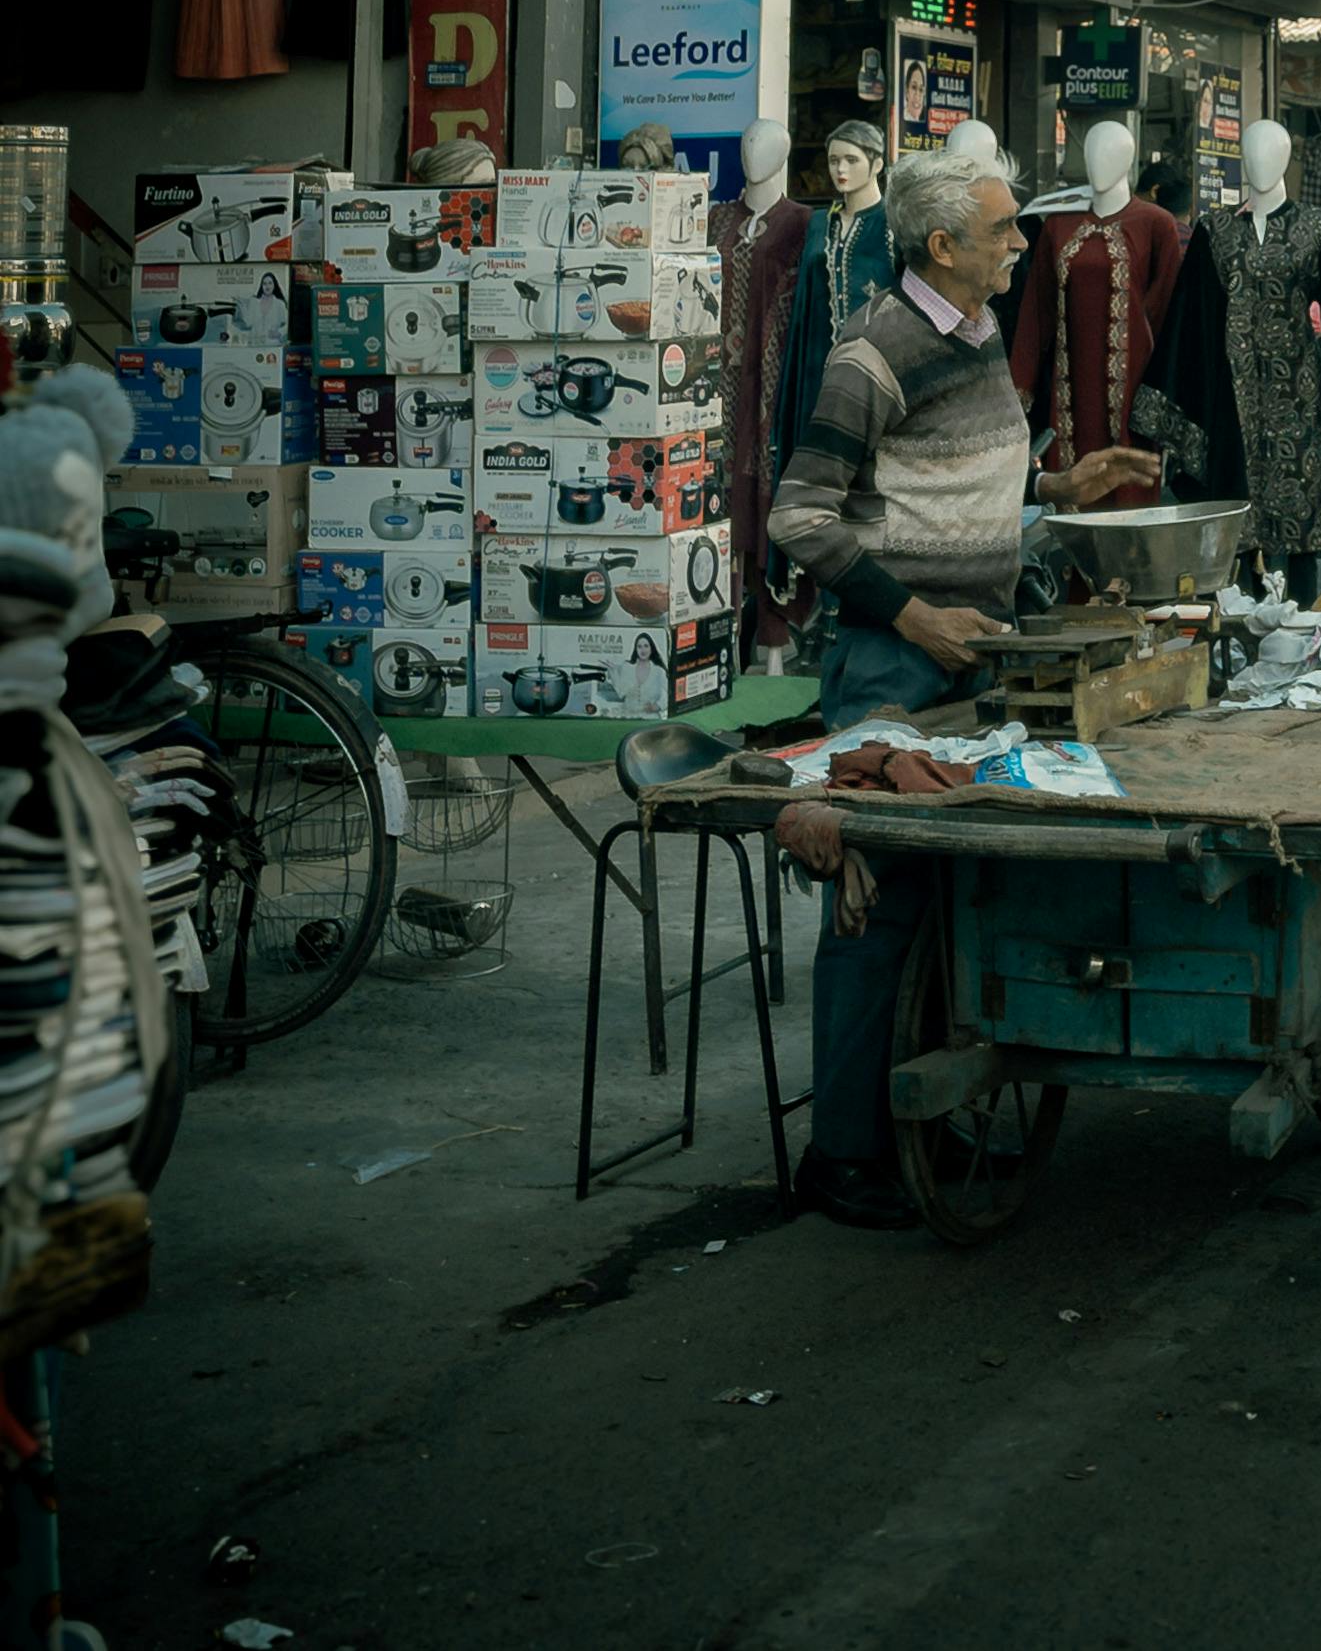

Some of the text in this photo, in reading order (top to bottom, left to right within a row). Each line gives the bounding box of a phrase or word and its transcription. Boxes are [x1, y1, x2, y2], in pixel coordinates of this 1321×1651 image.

[613, 29, 748, 68] Leeford
[1066, 64, 1129, 80] Contour
[1066, 80, 1129, 99] plus ELITE
[622, 92, 735, 104] We Care To Serve You Better!
[502, 176, 550, 186] MISS MARY
[144, 186, 194, 201] Furtino
[502, 187, 528, 196] Handi
[334, 210, 388, 221] INDIA GOLD
[486, 259, 527, 270] Hawkins
[216, 267, 255, 279] NATURA
[470, 325, 476, 335] 5
[486, 455, 547, 467] INDIA GOLD
[311, 527, 363, 538] COOKER
[489, 632, 525, 642] PRINGLE
[577, 634, 623, 645] NATURA
